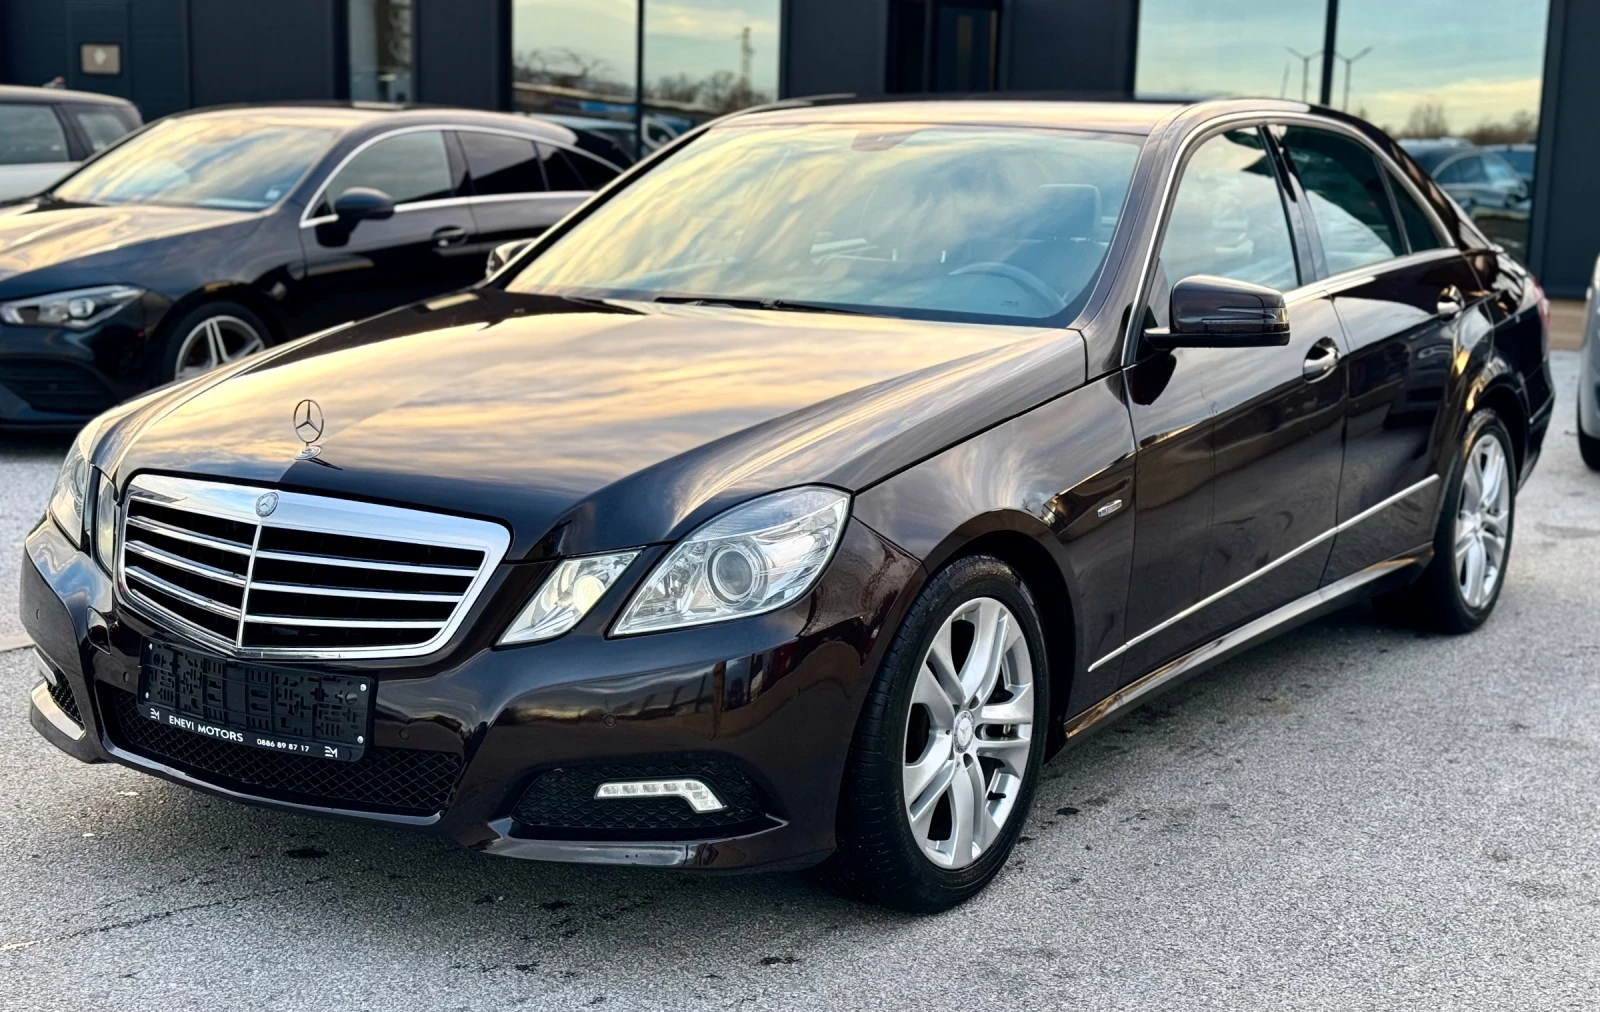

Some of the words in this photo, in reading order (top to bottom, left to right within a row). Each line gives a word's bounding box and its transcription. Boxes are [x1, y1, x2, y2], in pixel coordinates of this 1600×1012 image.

[169, 715, 195, 731] ENEVI
[198, 724, 244, 742] MOTORS
[256, 738, 275, 748] 0886
[277, 741, 287, 749] 89
[288, 743, 298, 751] 87
[300, 745, 310, 753] 17
